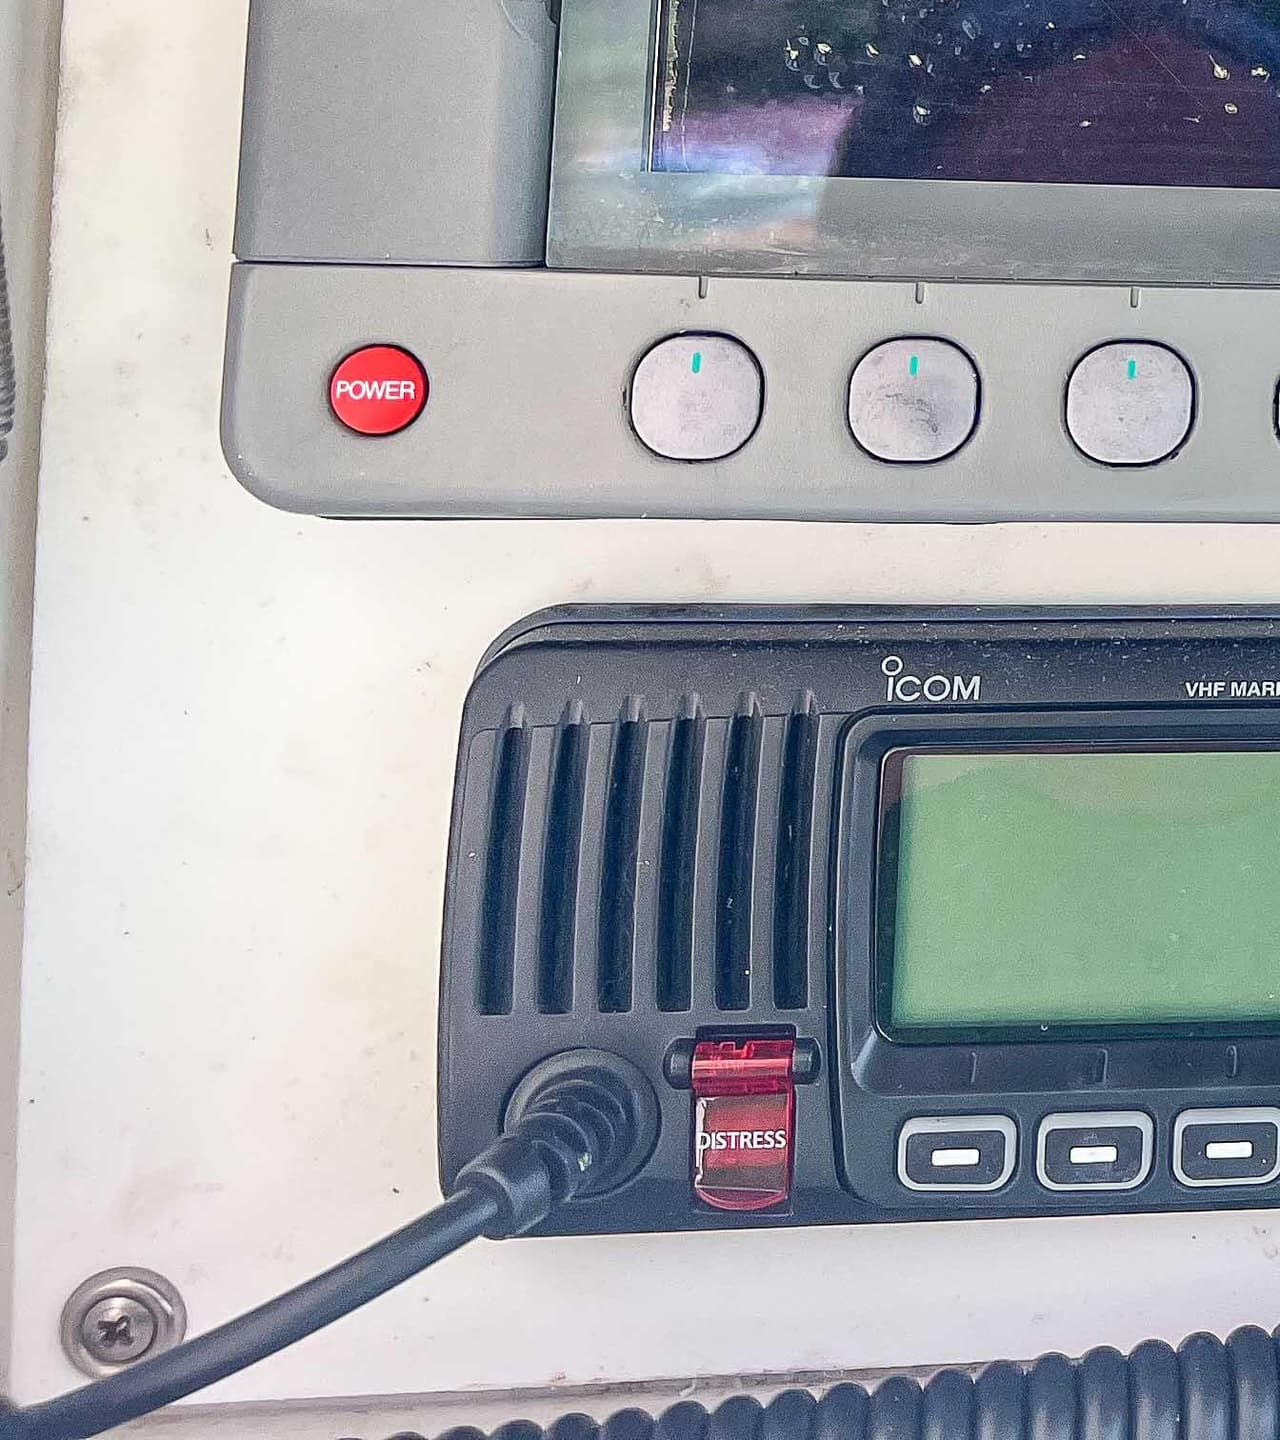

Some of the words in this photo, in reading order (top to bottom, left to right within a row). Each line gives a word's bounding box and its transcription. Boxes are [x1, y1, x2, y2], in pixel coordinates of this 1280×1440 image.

[335, 379, 416, 400] POWER
[1185, 680, 1227, 698] VHF
[696, 1129, 787, 1150] DISTRESS
